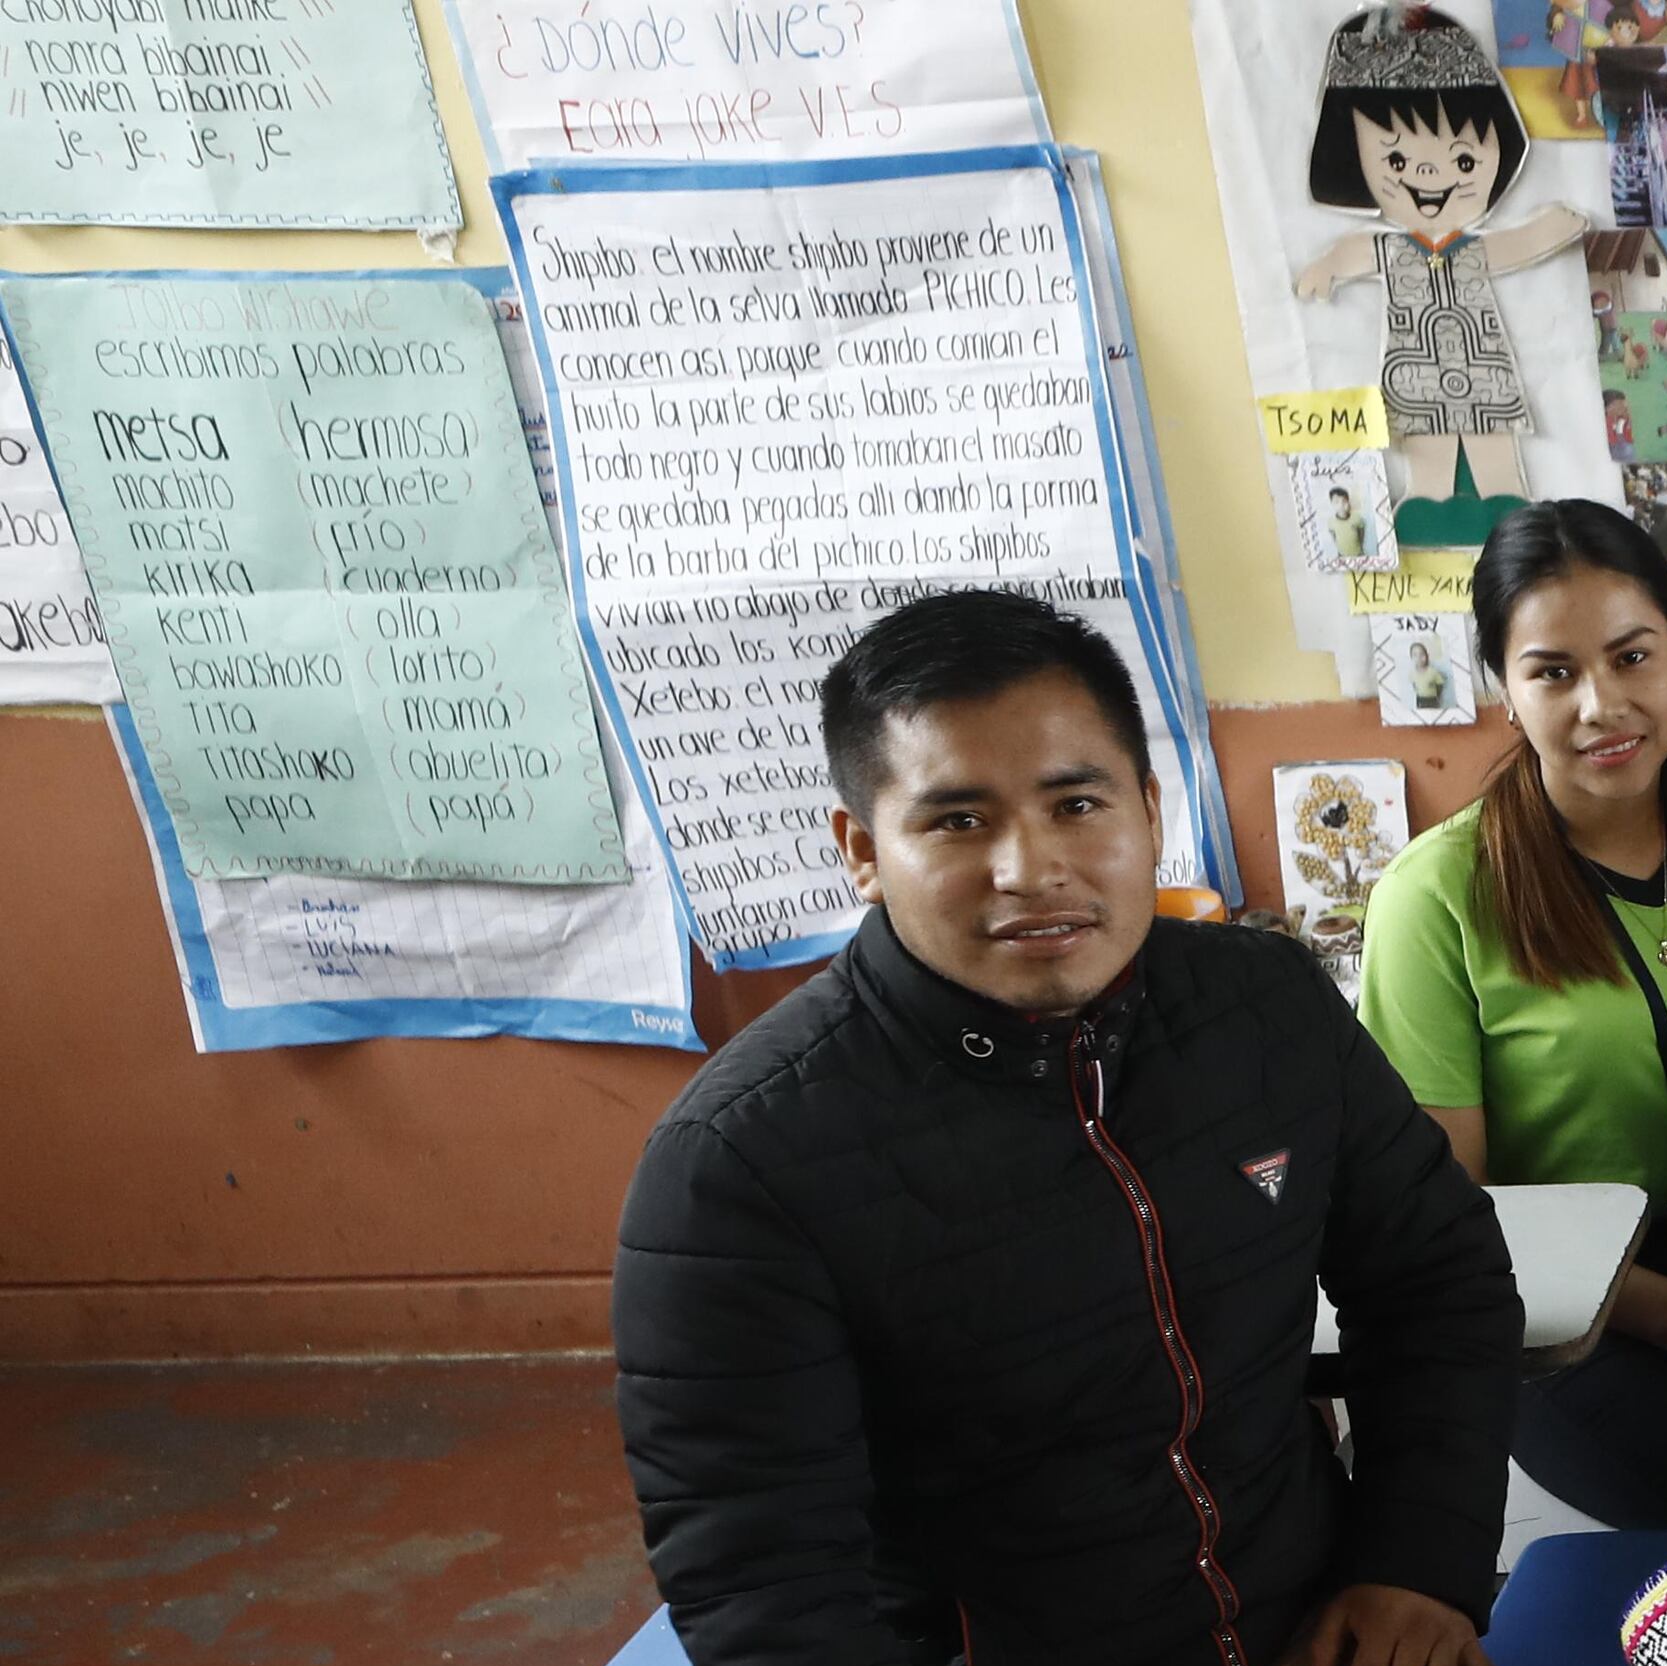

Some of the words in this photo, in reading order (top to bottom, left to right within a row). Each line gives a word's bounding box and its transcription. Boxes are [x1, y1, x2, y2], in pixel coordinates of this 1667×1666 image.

[254, 118, 291, 171] je
[653, 239, 682, 278] el
[691, 229, 781, 277] nombre
[789, 220, 868, 279] shipibo
[876, 229, 970, 278] proviene
[980, 218, 1012, 255] de
[544, 286, 640, 332] animal
[650, 288, 684, 327] de
[687, 286, 721, 324] la
[729, 281, 801, 323] selva
[807, 270, 907, 320] llamado
[1037, 265, 1078, 305] Les
[95, 338, 280, 379] escribimos
[292, 337, 465, 395] palabras
[559, 337, 674, 384] conocen
[737, 342, 821, 385] porque
[838, 327, 928, 367] cuando
[1034, 317, 1060, 356] el
[651, 385, 682, 428] la
[688, 389, 756, 435] parte
[766, 382, 799, 423] de
[807, 396, 855, 422] sus
[861, 376, 937, 418] labios
[946, 384, 977, 412] se
[982, 372, 1091, 425] quedaban
[1267, 404, 1369, 437] TSOMA
[93, 408, 230, 461] metsa
[577, 445, 643, 483] todo
[650, 447, 719, 492] negro
[724, 451, 745, 489] y
[753, 430, 845, 474] cuando
[852, 428, 957, 469] tomaban
[959, 422, 985, 464] el
[129, 516, 230, 552] matsi
[580, 501, 614, 534] se
[618, 490, 730, 545] quedaba
[743, 487, 849, 539] pegadas
[903, 476, 982, 517] dando
[986, 475, 1014, 510] la
[585, 541, 621, 581] de
[627, 539, 655, 578] la
[665, 528, 747, 576] barba
[759, 525, 800, 572] del
[913, 520, 952, 563] Los
[959, 517, 1050, 578] shipibos
[169, 648, 342, 691] bawashoko
[184, 700, 256, 736] tita
[198, 745, 354, 782] titashoko
[226, 793, 315, 835] papa
